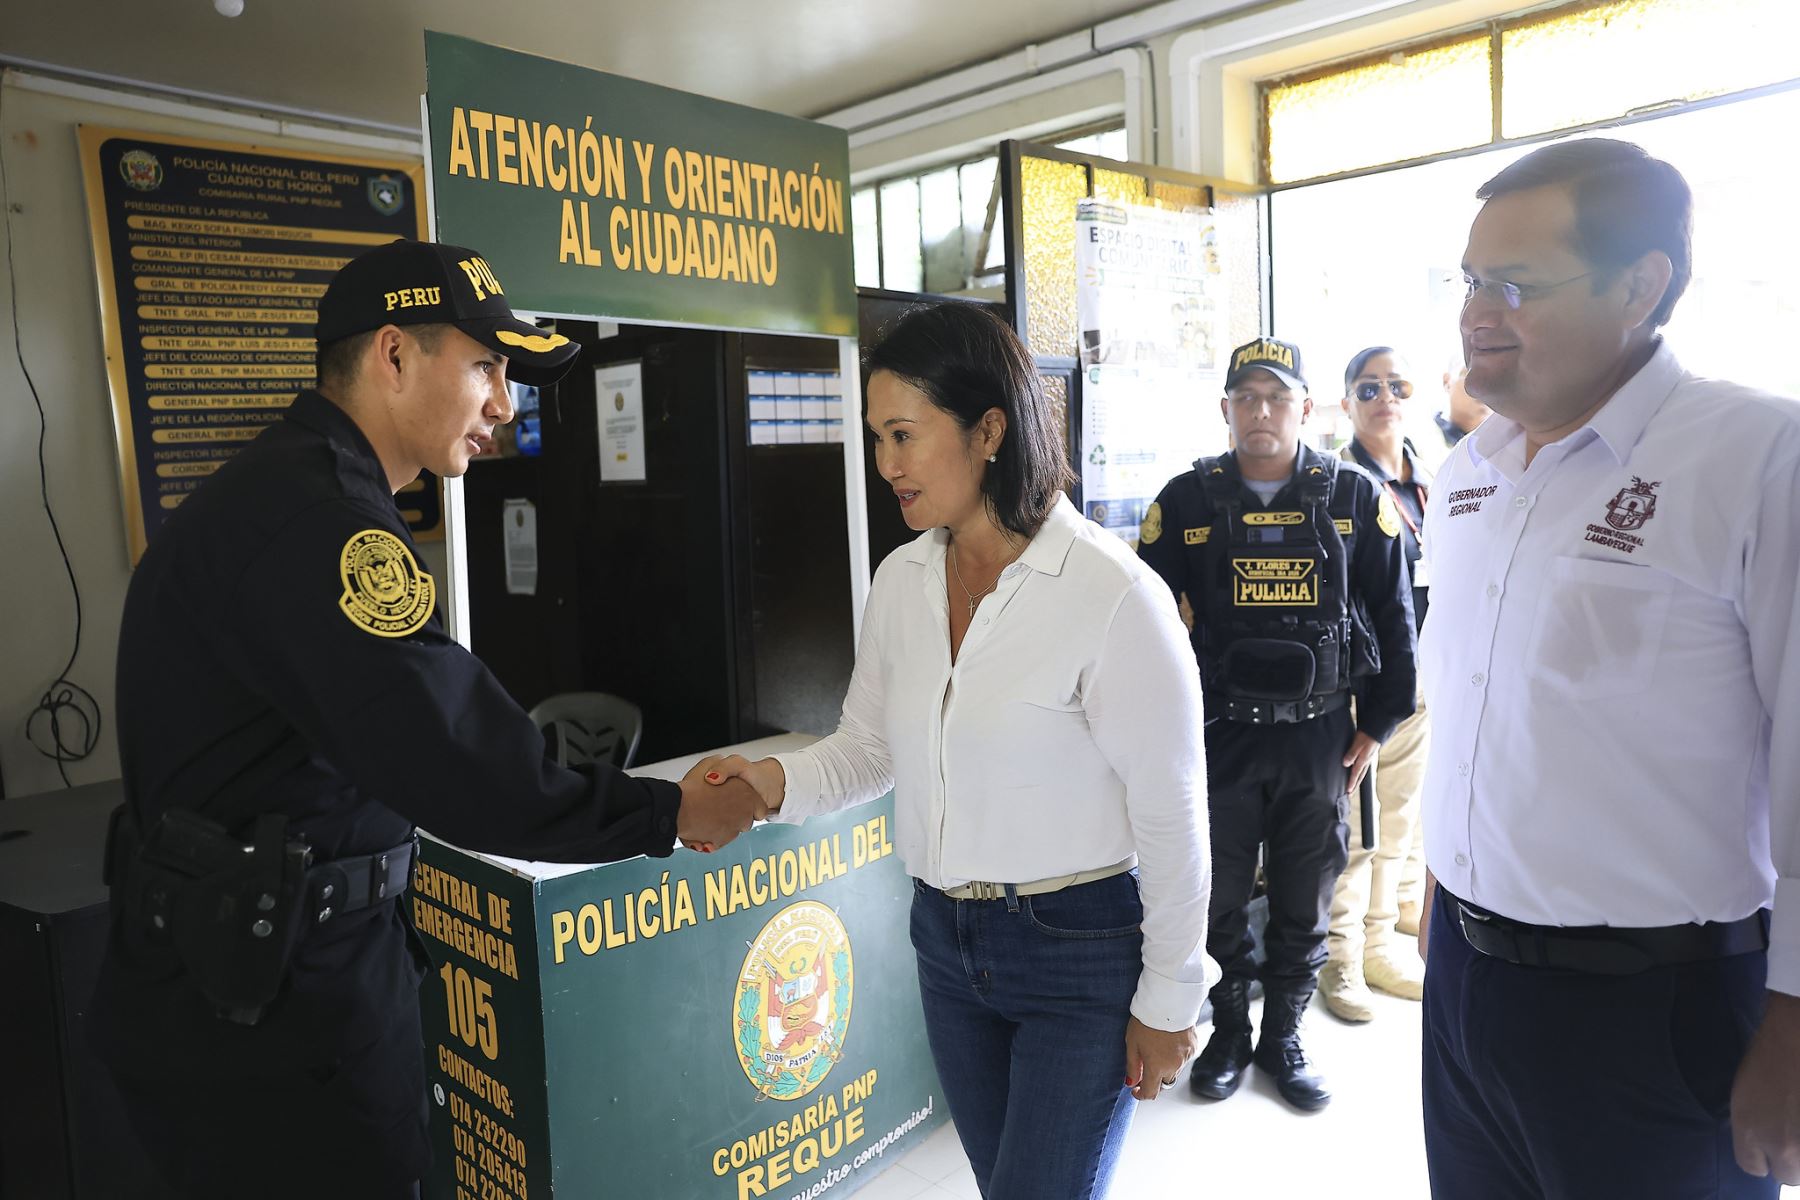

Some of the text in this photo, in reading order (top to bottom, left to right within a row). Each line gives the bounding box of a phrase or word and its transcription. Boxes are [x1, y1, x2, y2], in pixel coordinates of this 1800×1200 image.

[173, 156, 359, 186] POLICÍA NACIONAL DEL PERÚ
[449, 106, 844, 234] ATENCIÓN Y ORIENTACIÓN
[208, 174, 332, 194] CUADRO DE HONOR
[125, 201, 185, 214] PRESIDENTE
[188, 206, 201, 215] DE
[203, 207, 217, 217] LA
[290, 195, 310, 206] PNP
[311, 198, 342, 209] REQUE
[171, 220, 201, 231] KEIKO
[128, 233, 242, 248] MINISTRO DEL INTERIOR
[559, 199, 779, 287] AL CIUDADANO
[179, 251, 193, 260] EP
[243, 255, 286, 265] AUGUSTO
[131, 264, 296, 280] COMANDANTE GENERAL DE LA PNP
[182, 281, 195, 290] DE
[136, 294, 161, 304] JEFE
[163, 295, 182, 304] DEL
[184, 295, 223, 306] ESTADO
[224, 297, 257, 306] MAYOR
[258, 298, 299, 307] GENERAL
[301, 299, 314, 308] DE
[384, 286, 441, 311] PERU
[237, 311, 257, 320] LUIS
[139, 324, 288, 336] INSPECTOR GENERAL DE LA PNP
[240, 340, 260, 349] LUIS
[143, 353, 167, 362] JEFE
[169, 353, 189, 362] DEL
[190, 353, 240, 362] COMANDO
[242, 353, 255, 362] DE
[1235, 341, 1293, 371] POLICIA
[242, 366, 278, 376] MANUEL
[145, 382, 195, 391] DIRECTOR
[197, 381, 246, 391] NACIONAL
[247, 381, 259, 390] DE
[260, 381, 292, 390] ORDEN
[164, 398, 208, 407] GENERAL
[211, 398, 230, 407] PNP
[232, 397, 269, 406] SAMUEL
[150, 415, 174, 425] JEFE
[176, 414, 191, 424] DE
[192, 414, 206, 424] LA
[168, 431, 213, 440] GENERAL
[215, 430, 233, 440] PNP
[153, 449, 210, 461] INSPECTOR
[1449, 485, 1497, 503] GOBERNADOR
[1449, 501, 1481, 517] REGIONAL
[1584, 532, 1636, 553] LAMBAYEQUE
[1257, 562, 1290, 570] FLORES
[1240, 582, 1312, 601] POLICIA
[552, 815, 894, 964] POLICÍA NACIONAL DEL
[413, 862, 512, 936] CENTRAL DE
[413, 896, 518, 980] EMERGENCIA
[440, 961, 499, 1061] 105
[766, 1053, 784, 1063] DIOS
[789, 1049, 817, 1068] PATRIA
[438, 1044, 514, 1119] CONTACTOS:
[449, 1092, 527, 1168] 074 232290
[712, 1069, 878, 1177] COMISARÍA PNP
[853, 1095, 933, 1169] compromiso!
[453, 1124, 528, 1200] 074 205413
[737, 1106, 865, 1200] REQUE
[455, 1155, 478, 1194] 074
